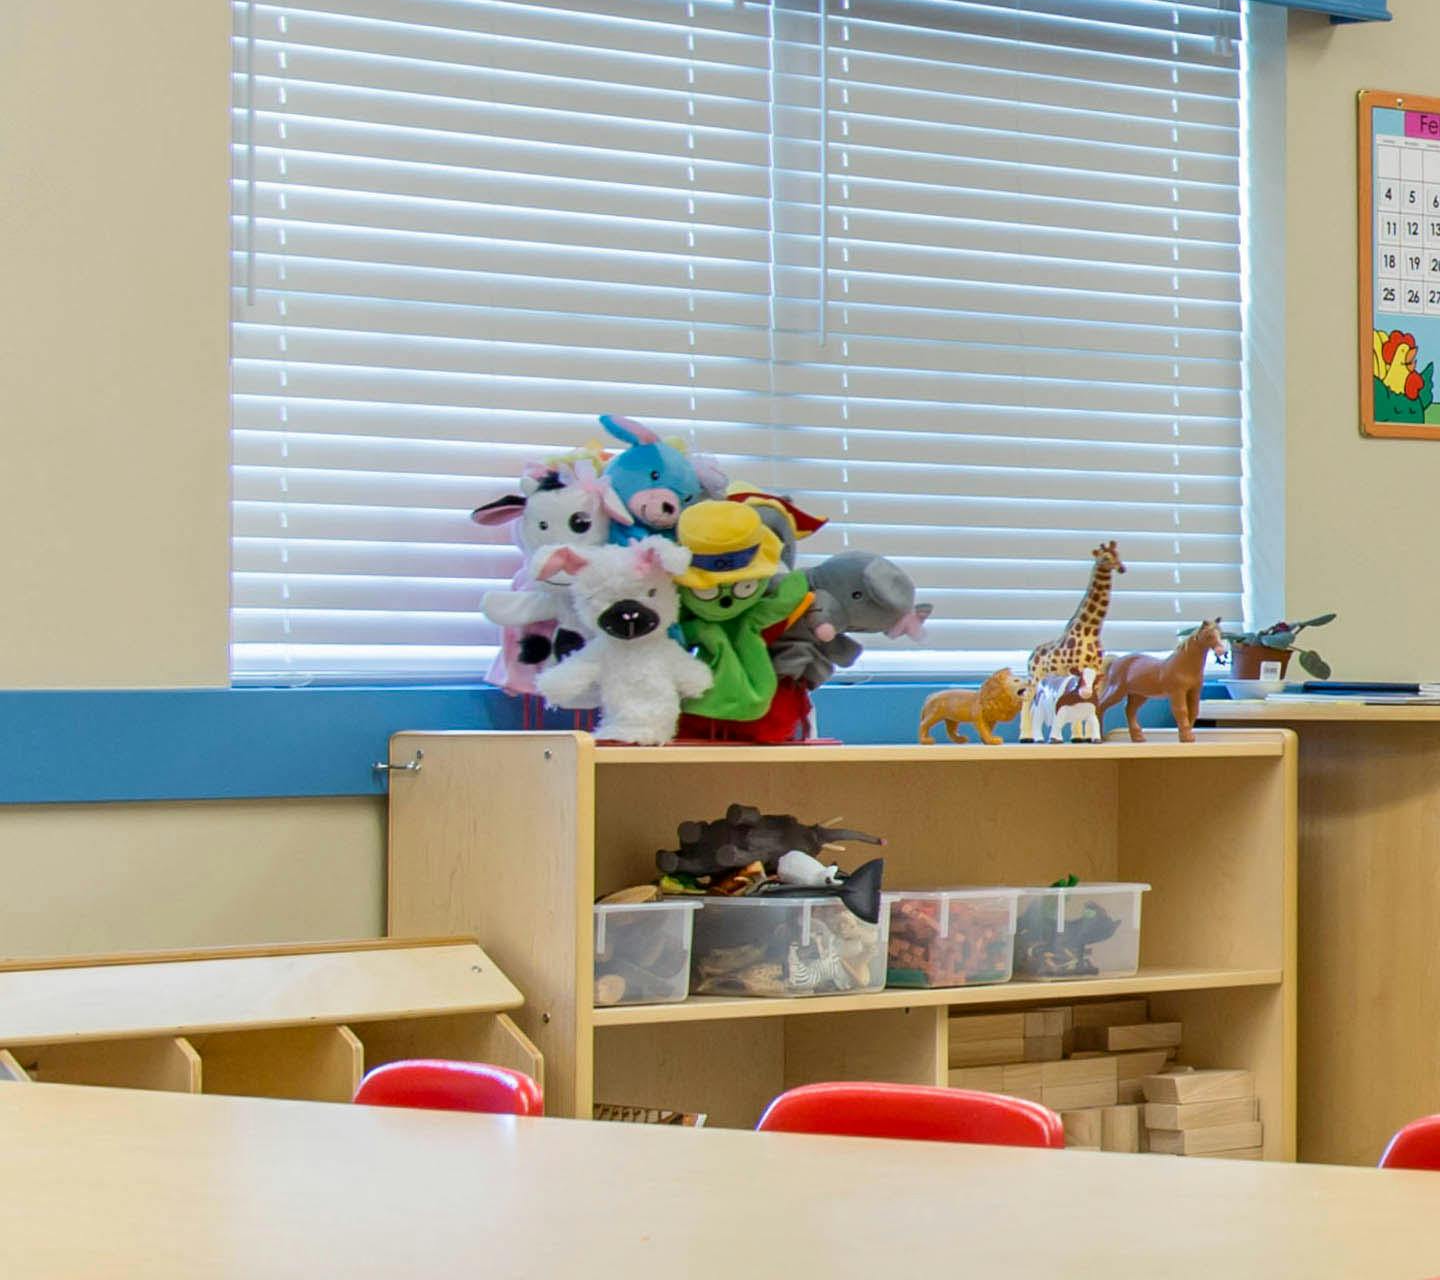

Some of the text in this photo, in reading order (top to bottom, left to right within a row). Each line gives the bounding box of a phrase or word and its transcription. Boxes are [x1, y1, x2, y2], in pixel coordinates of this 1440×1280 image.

[1384, 187, 1392, 201] 4
[1408, 190, 1416, 204] 5
[1432, 195, 1440, 209] 6
[1386, 221, 1397, 236] 11
[1407, 222, 1419, 236] 12
[1383, 254, 1396, 269] 18
[1408, 256, 1421, 271] 19
[1383, 287, 1396, 302] 25
[1407, 289, 1420, 304] 26
